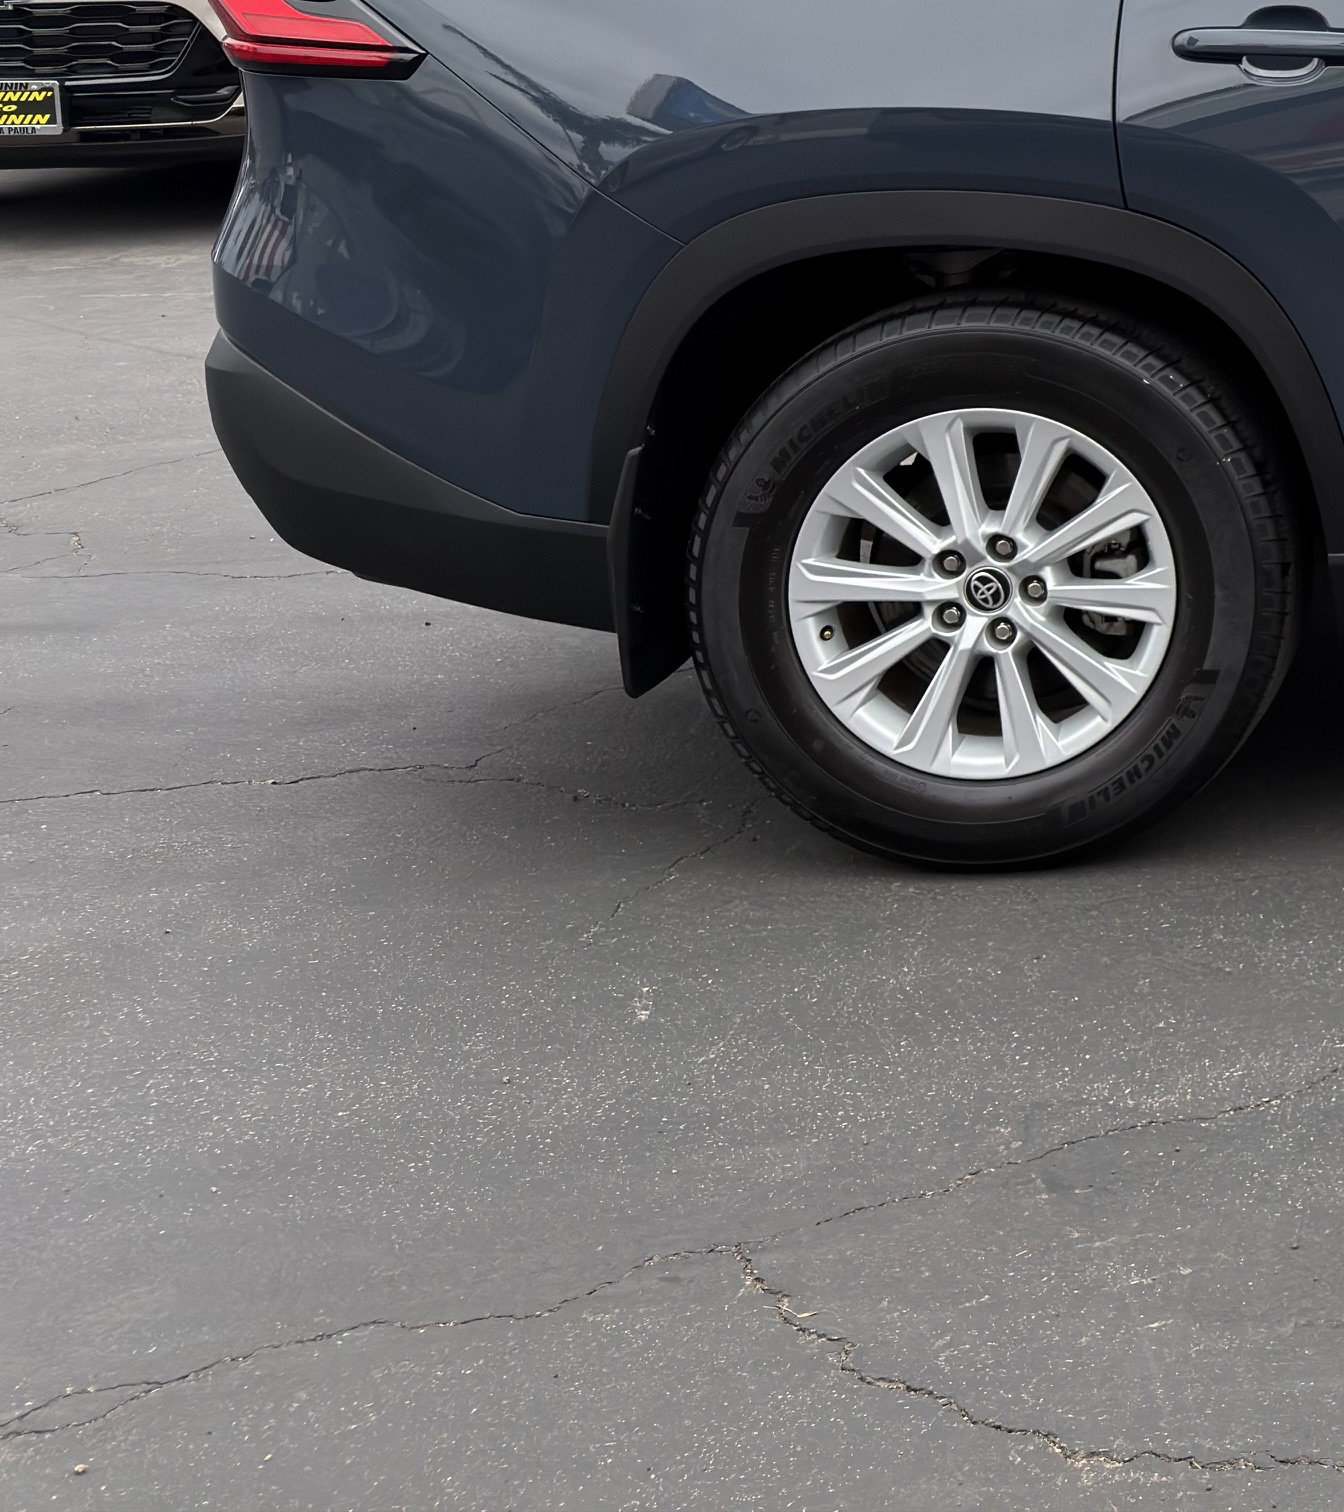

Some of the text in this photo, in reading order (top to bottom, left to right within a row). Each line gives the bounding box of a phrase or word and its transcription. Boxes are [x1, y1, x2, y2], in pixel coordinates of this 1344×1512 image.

[0, 91, 53, 101] NIN'
[9, 127, 37, 135] PAULA
[1067, 722, 1183, 818] MICHELIN
